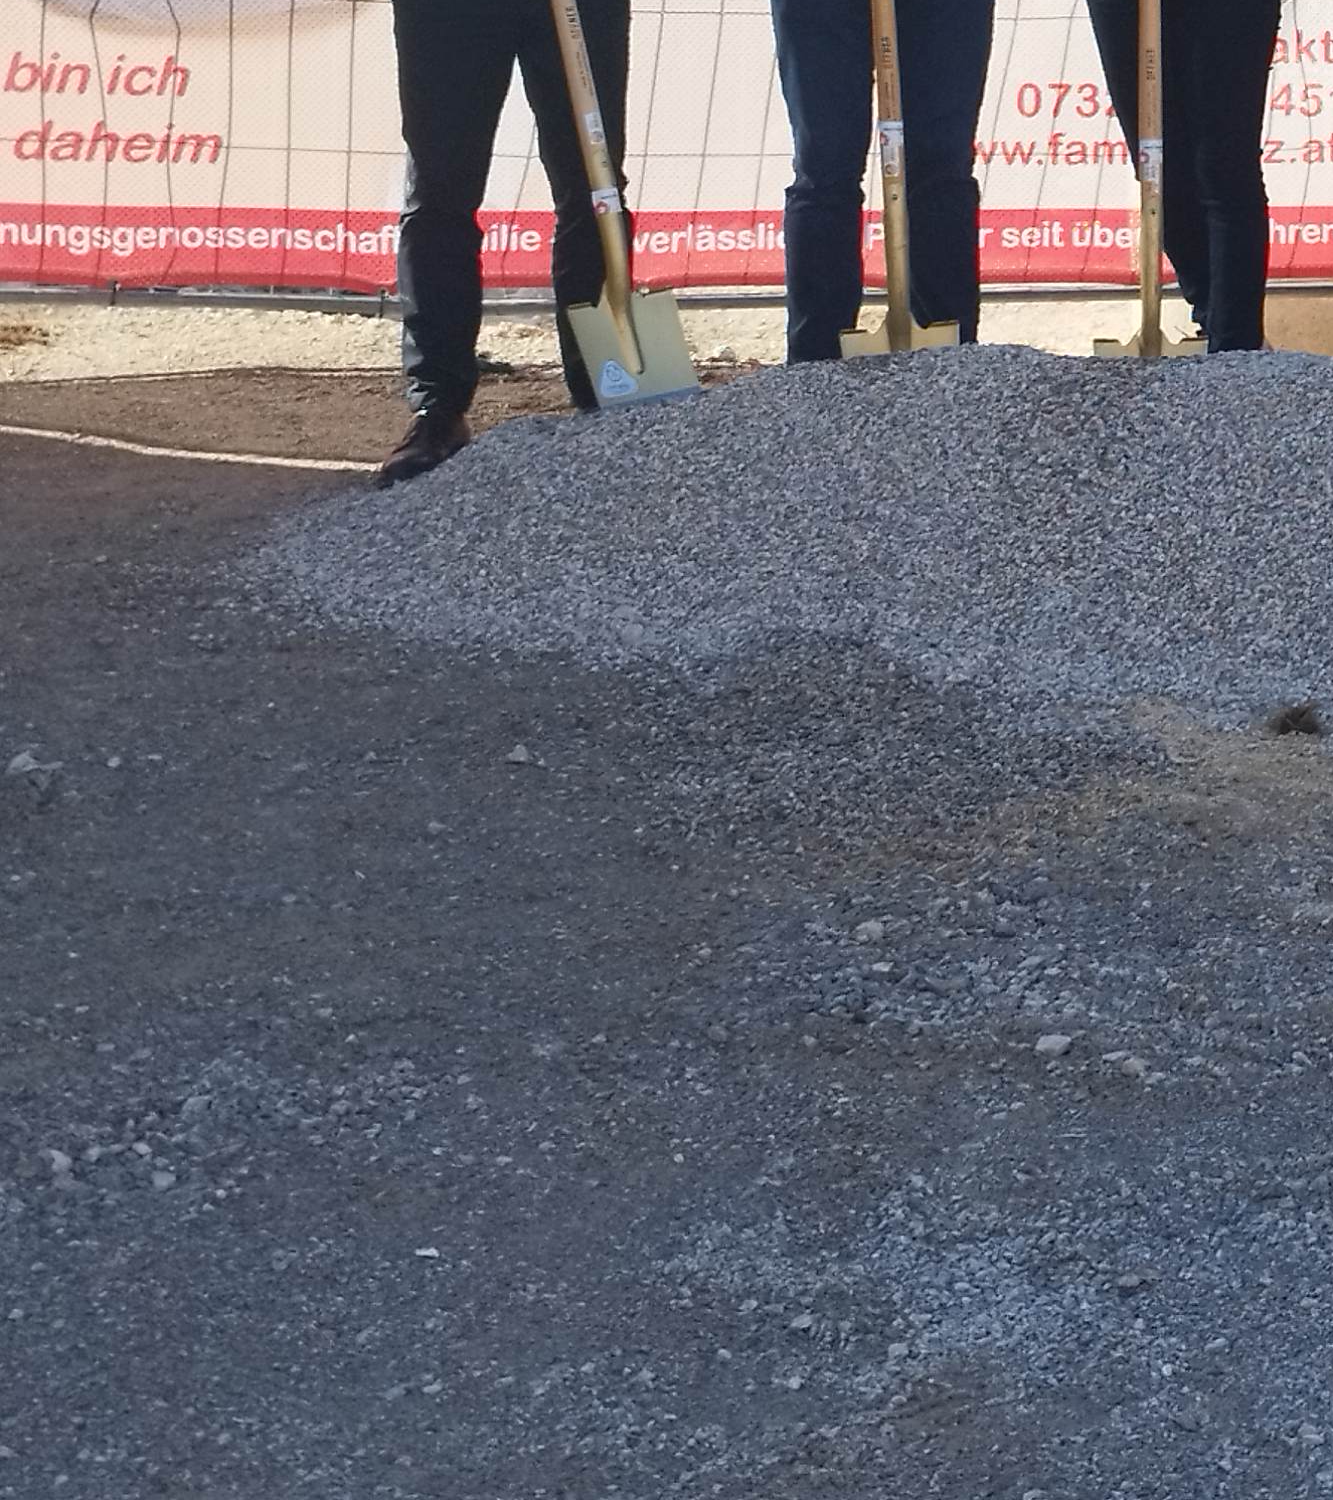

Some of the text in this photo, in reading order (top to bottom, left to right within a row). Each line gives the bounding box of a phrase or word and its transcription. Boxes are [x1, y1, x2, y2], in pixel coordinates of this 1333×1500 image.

[3, 51, 191, 97] bin ich
[13, 120, 223, 164] daheim
[481, 223, 541, 253] ilie
[1001, 220, 1063, 249] seit
[1072, 218, 1141, 249] übe
